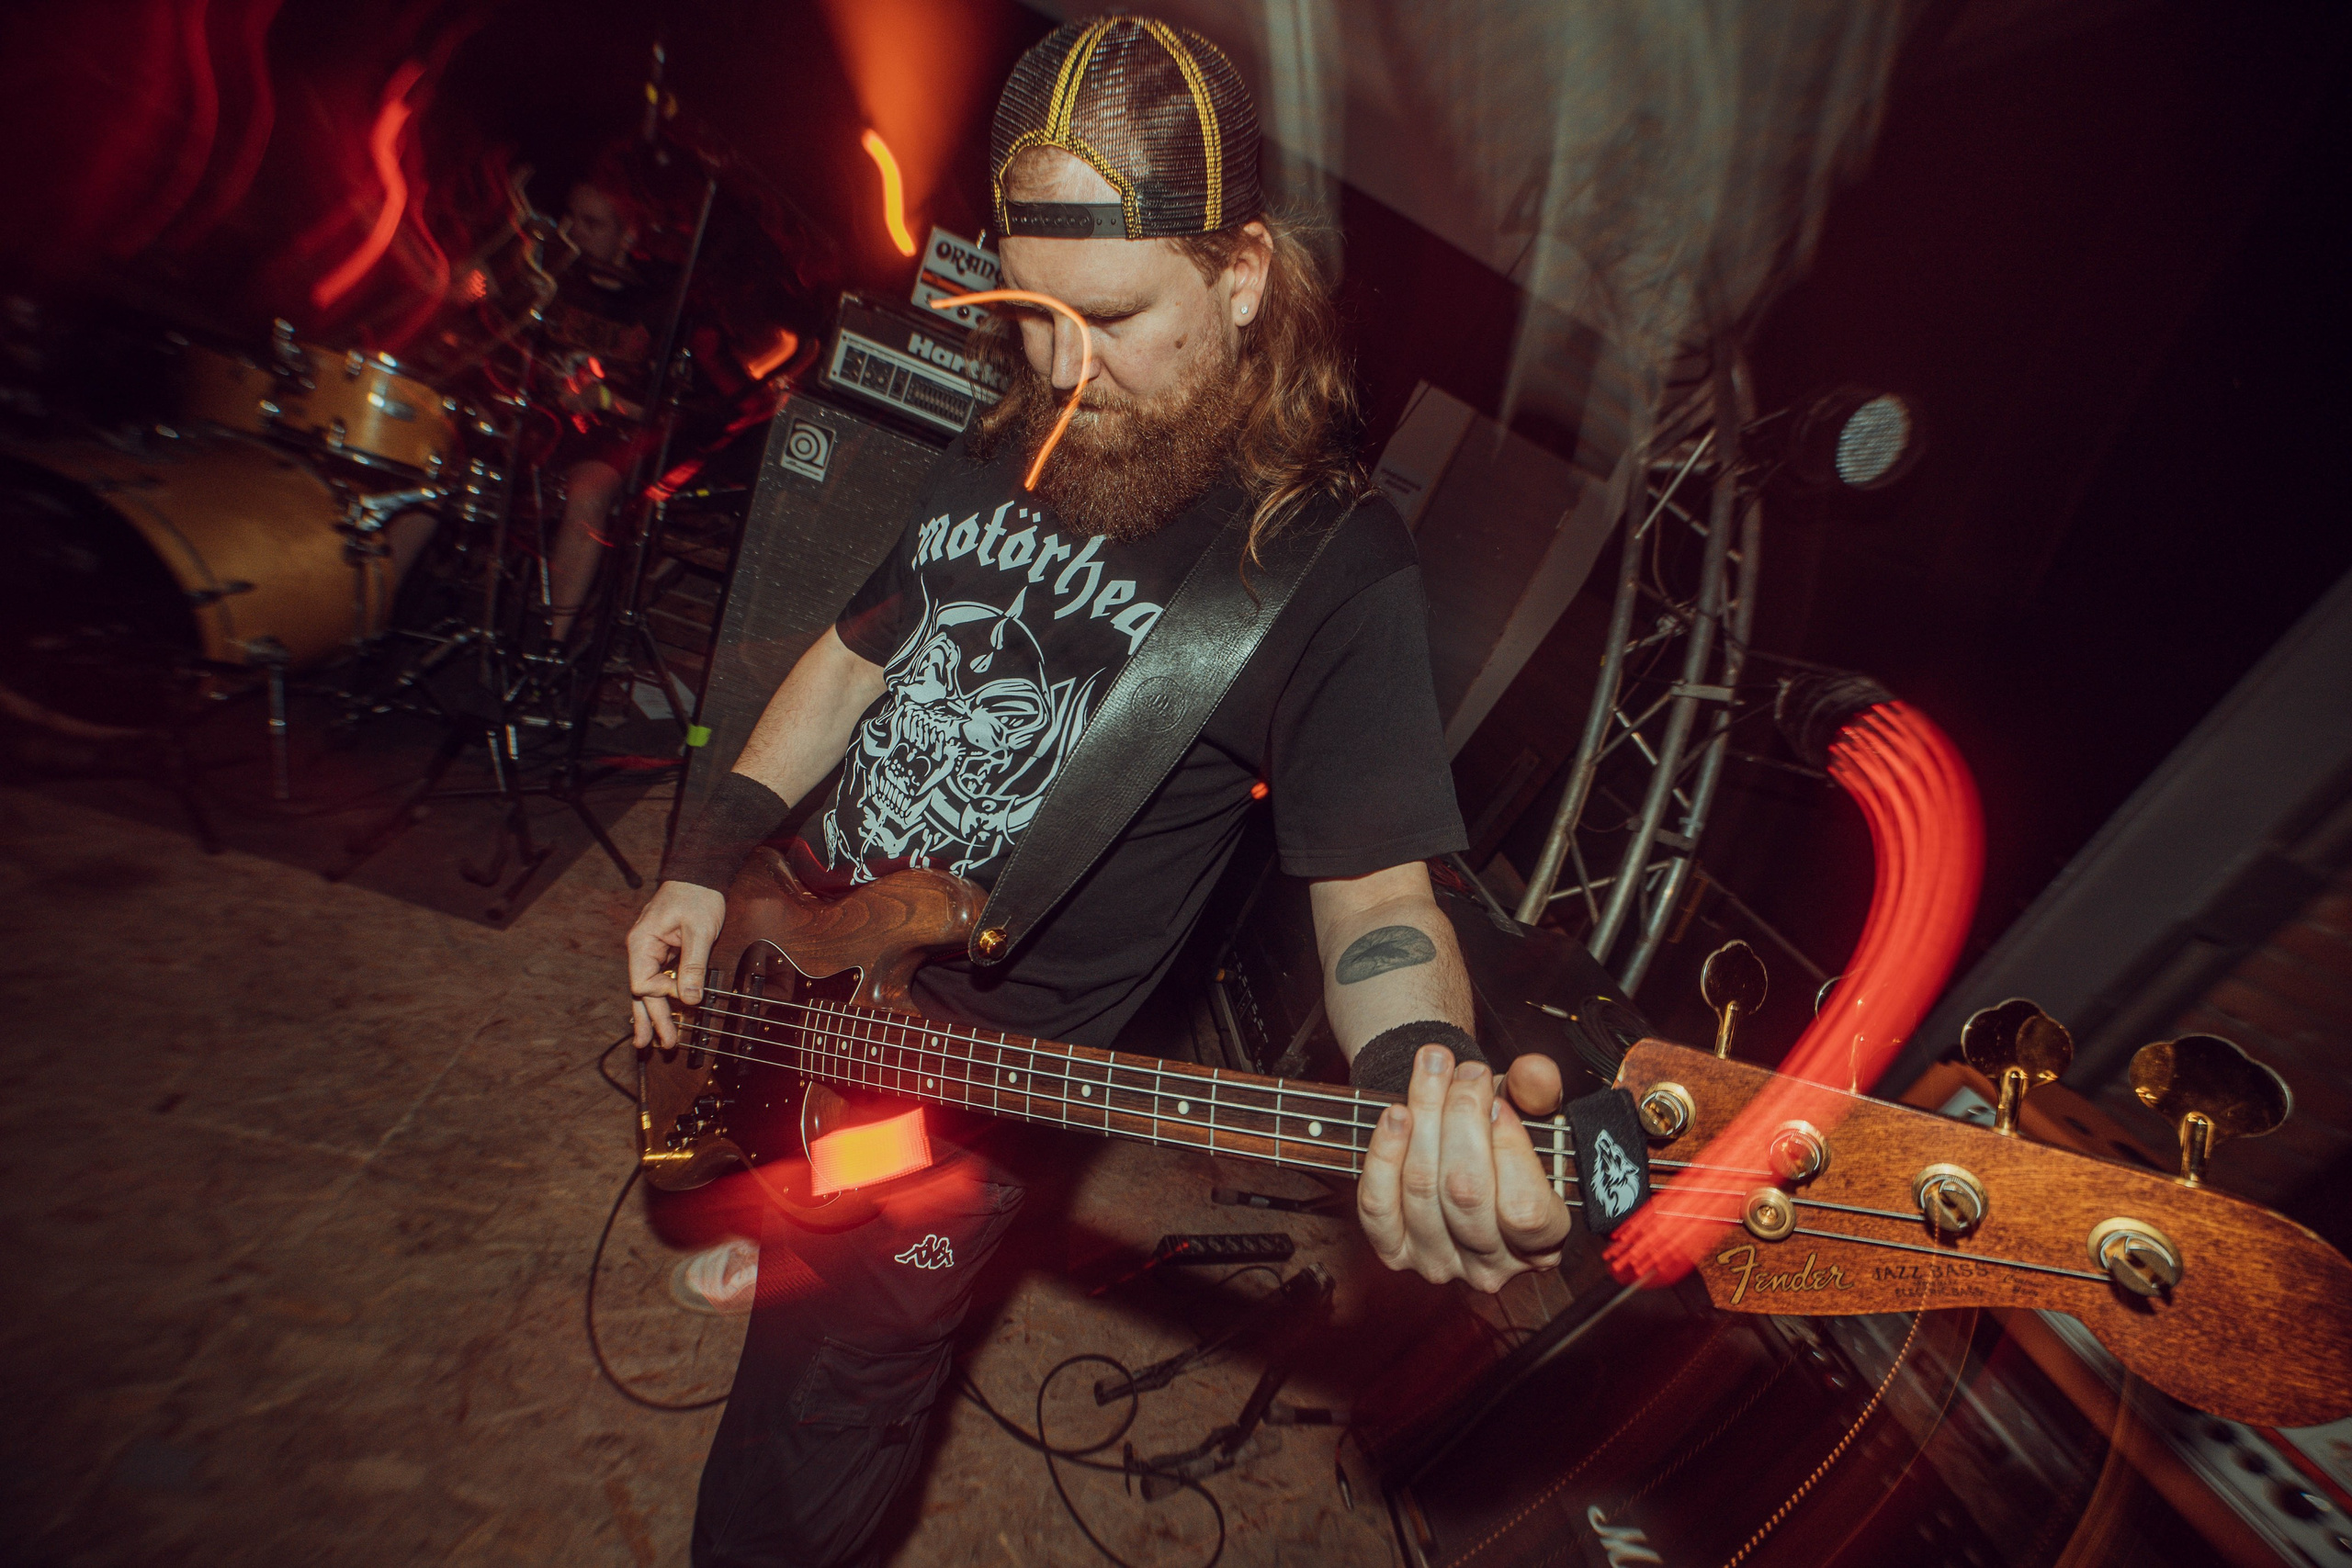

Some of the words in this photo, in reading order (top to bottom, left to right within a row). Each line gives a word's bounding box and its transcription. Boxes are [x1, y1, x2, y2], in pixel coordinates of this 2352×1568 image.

[935, 240, 1004, 288] ORAN
[907, 332, 1009, 391] Hartk
[911, 500, 1164, 656] motörhea
[1716, 1244, 1855, 1305] Fender
[1871, 1265, 1923, 1281] JAZZ
[1930, 1262, 1989, 1279] BASS
